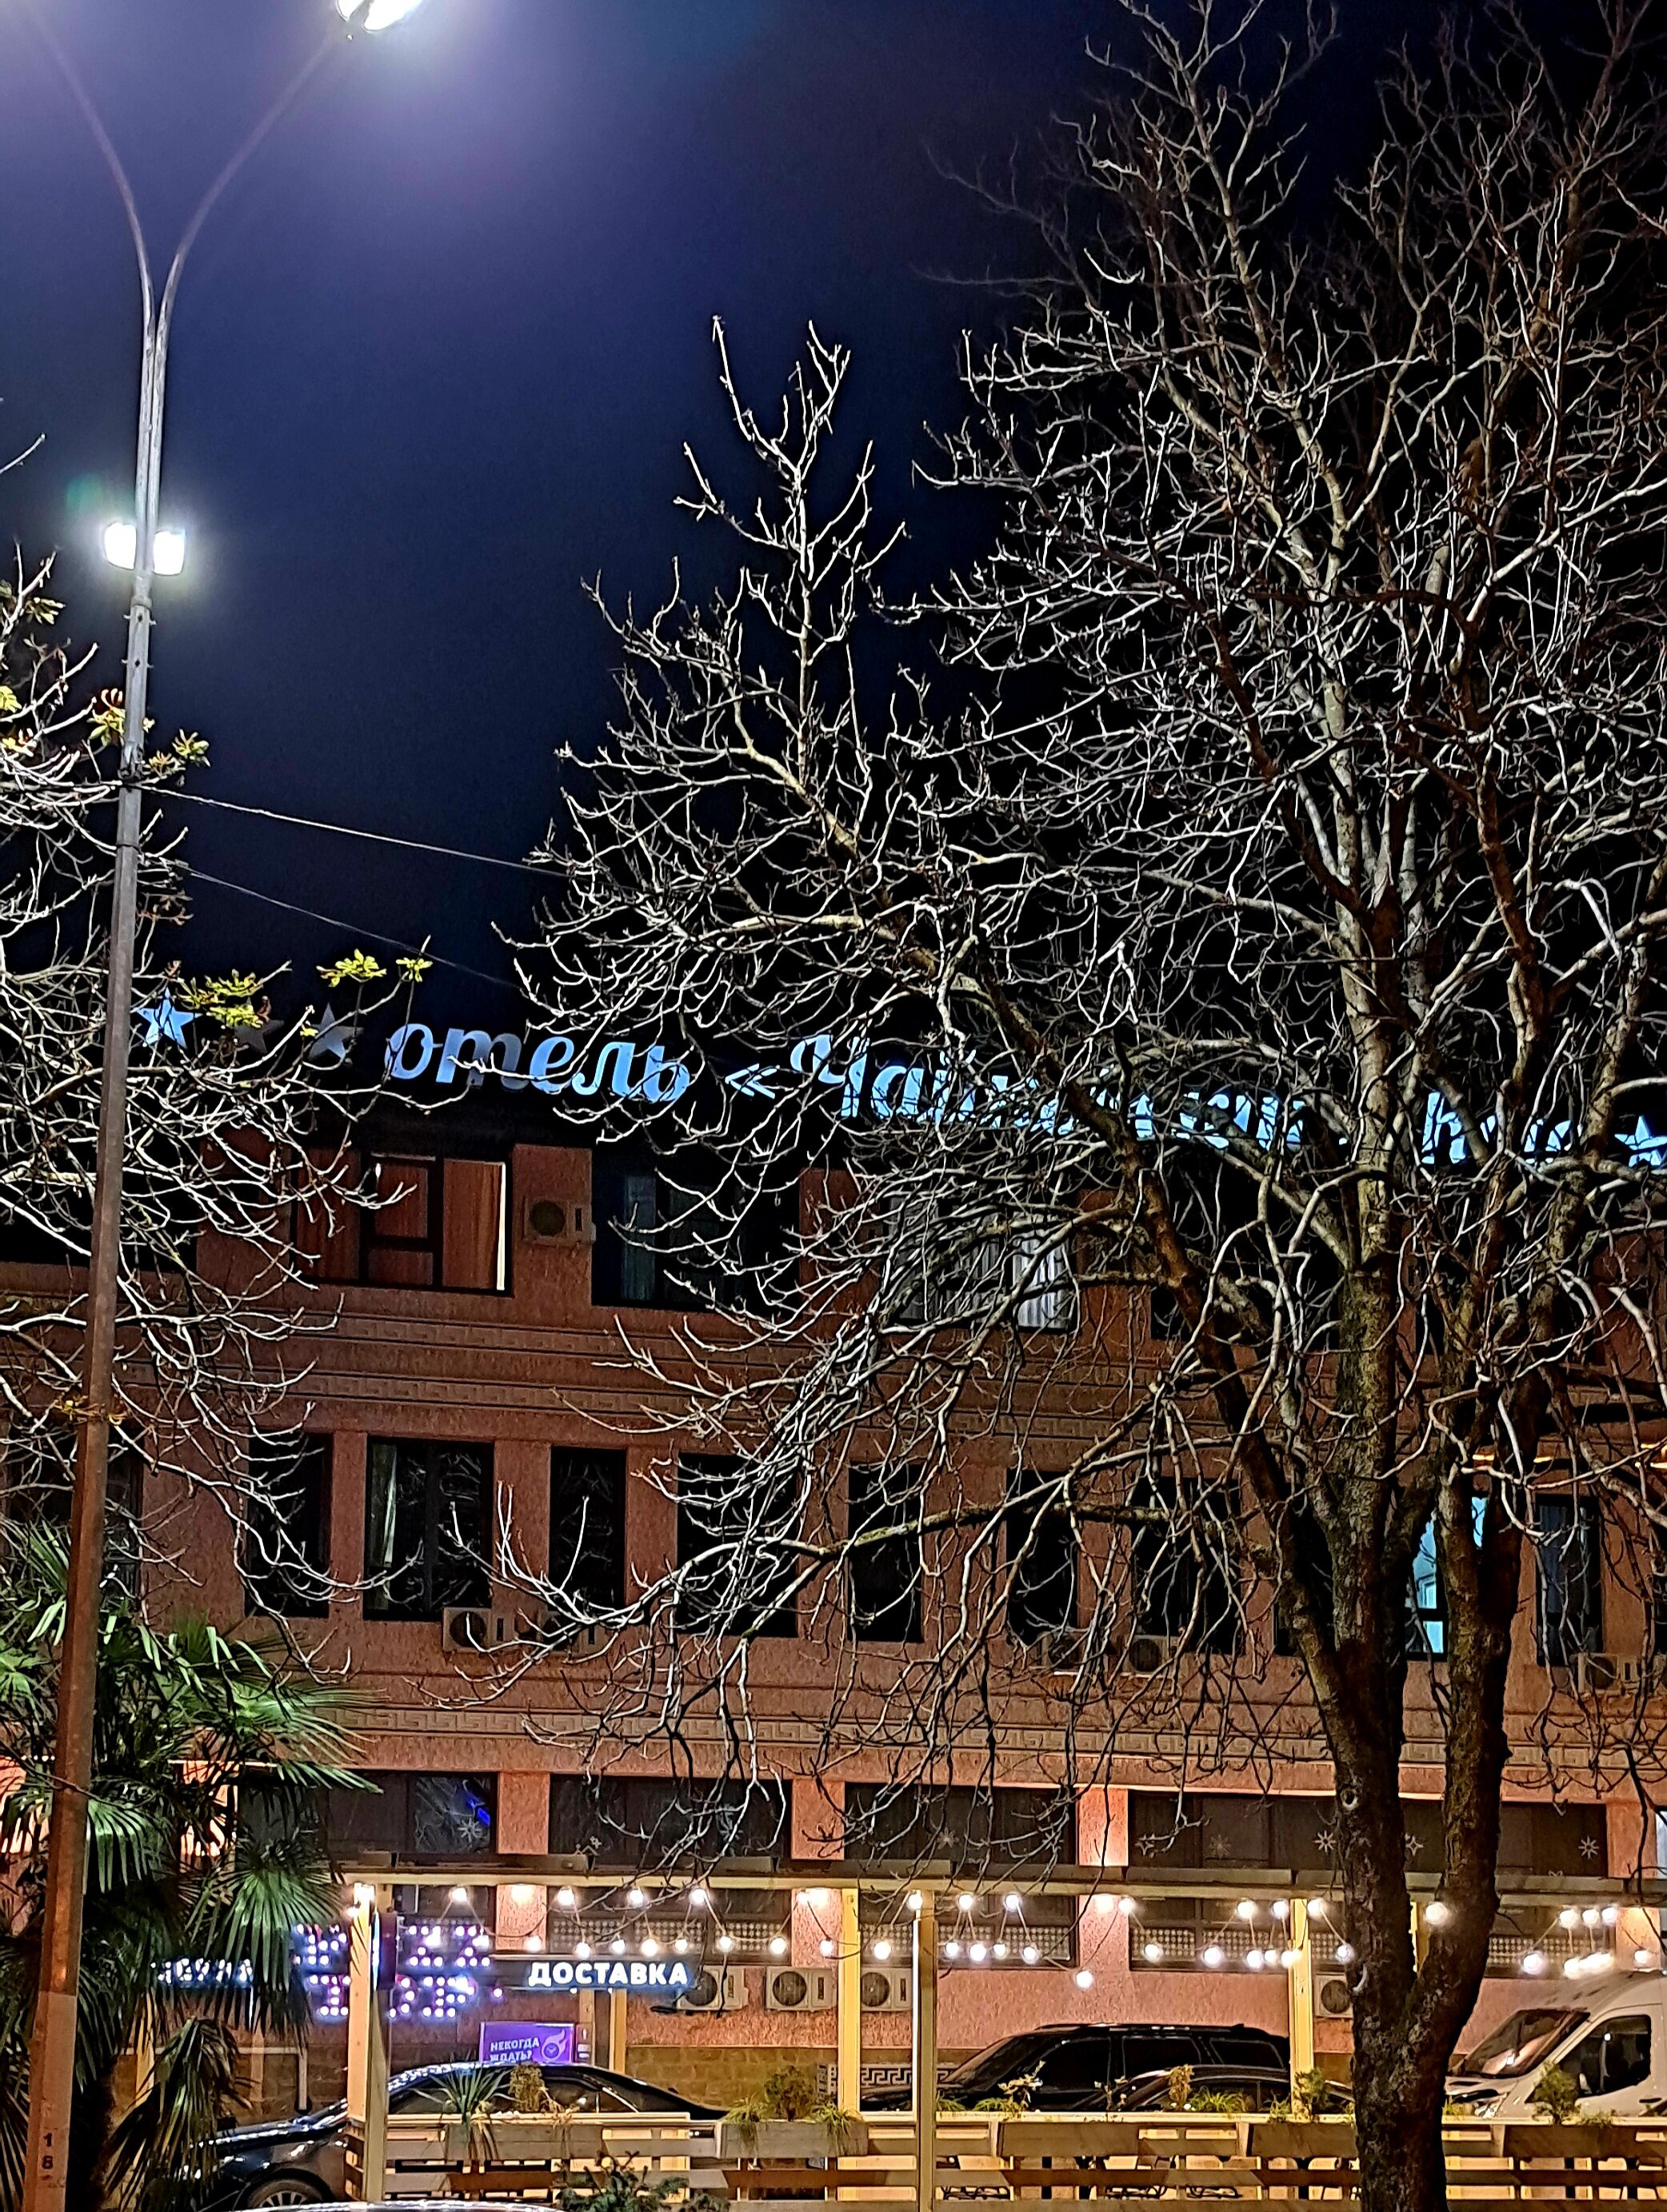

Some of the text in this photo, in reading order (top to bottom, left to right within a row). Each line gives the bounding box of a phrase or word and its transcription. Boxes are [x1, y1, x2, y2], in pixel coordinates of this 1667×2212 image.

[384, 1023, 691, 1104] отель
[528, 1961, 688, 1987] ДОСТАВКА
[490, 2037, 540, 2052] НЕКОГДА
[490, 2050, 533, 2063] ЖДАТЬ?
